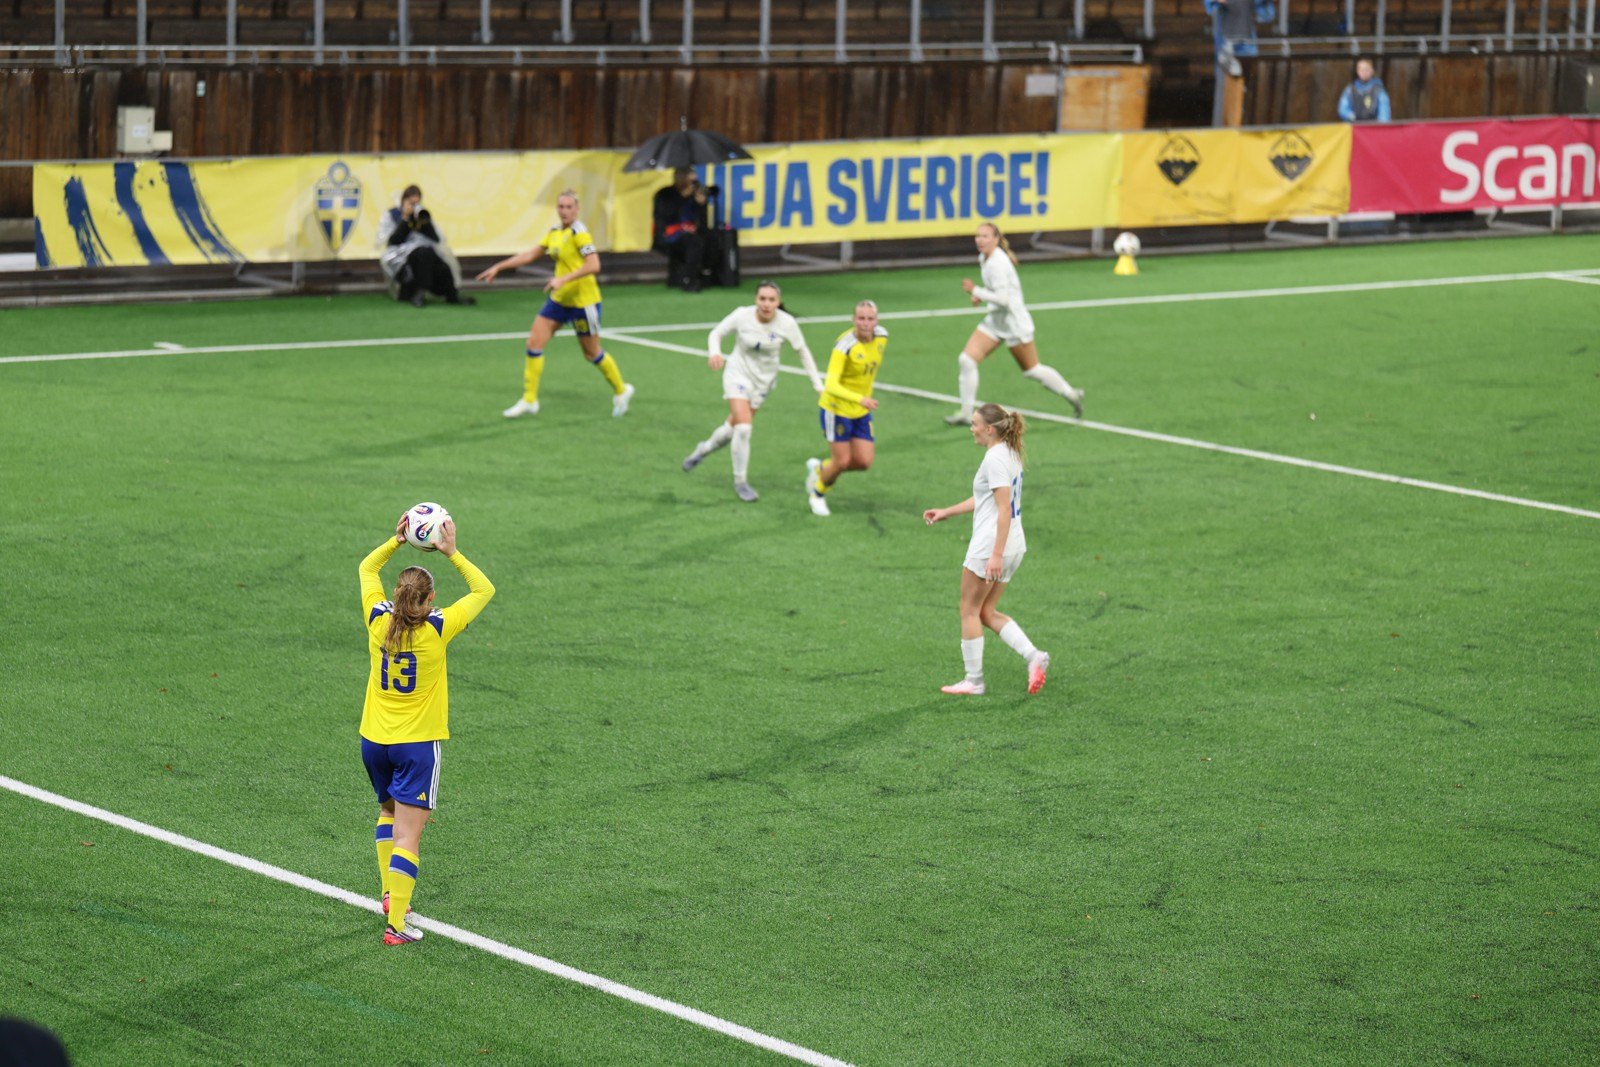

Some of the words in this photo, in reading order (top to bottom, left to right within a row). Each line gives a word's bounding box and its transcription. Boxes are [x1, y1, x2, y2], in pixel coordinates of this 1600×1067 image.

[827, 151, 1050, 226] SVERIGE!
[1440, 129, 1600, 204] Scan
[380, 647, 417, 694] 13
